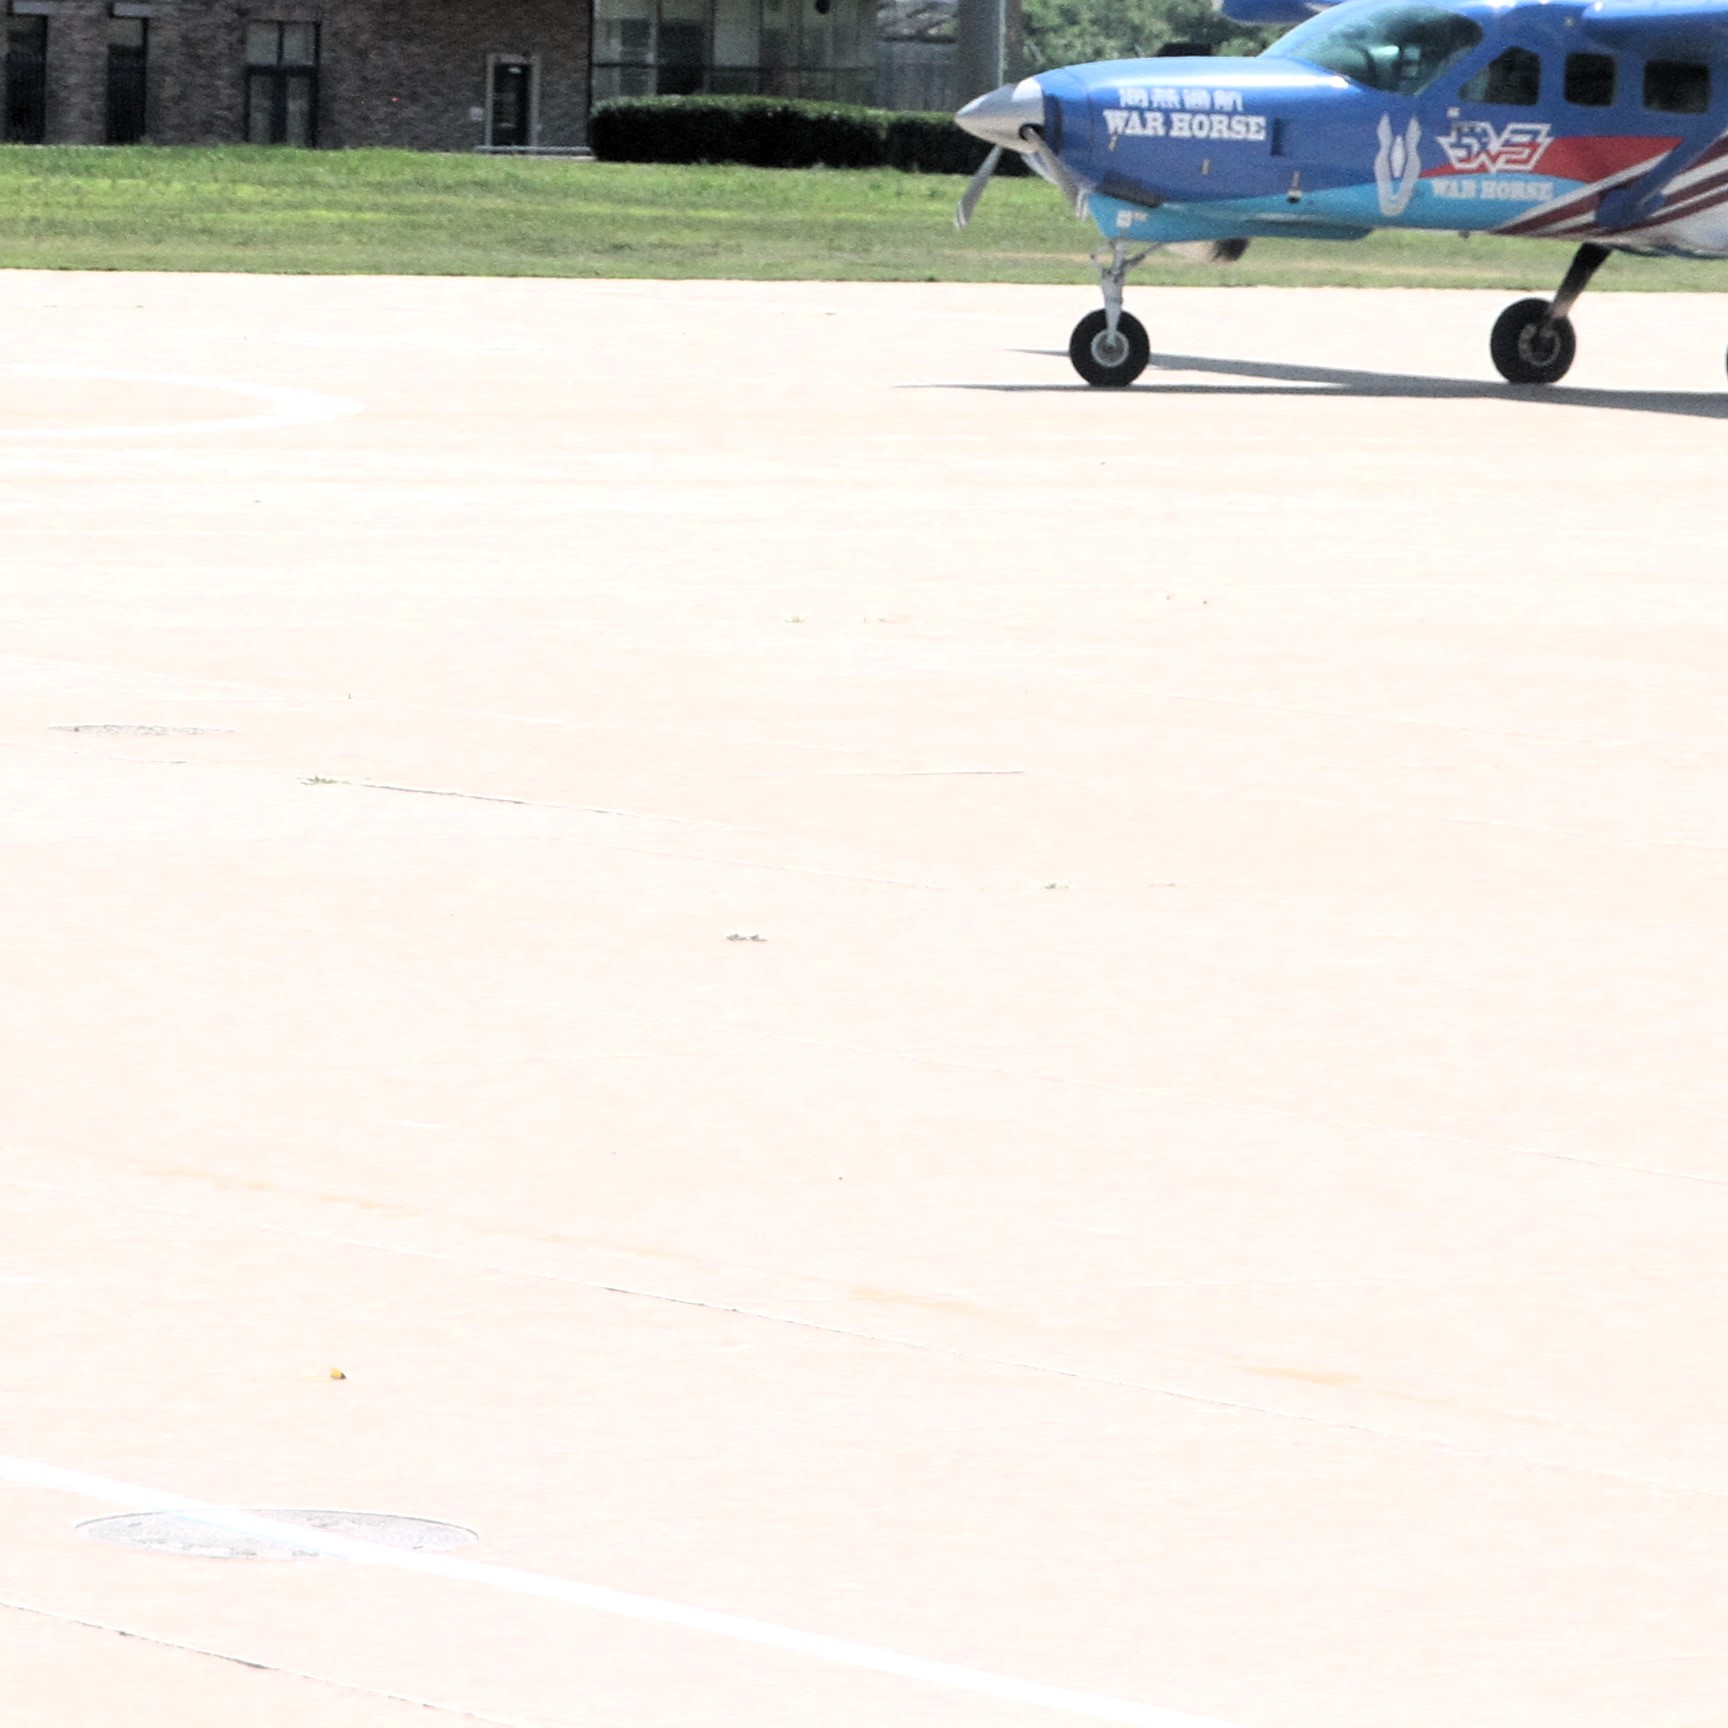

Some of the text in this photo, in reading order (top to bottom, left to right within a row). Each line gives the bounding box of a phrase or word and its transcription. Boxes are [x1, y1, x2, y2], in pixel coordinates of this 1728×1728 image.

[1102, 108, 1268, 142] WAR HORSE
[1431, 177, 1554, 202] WAR HORSE
